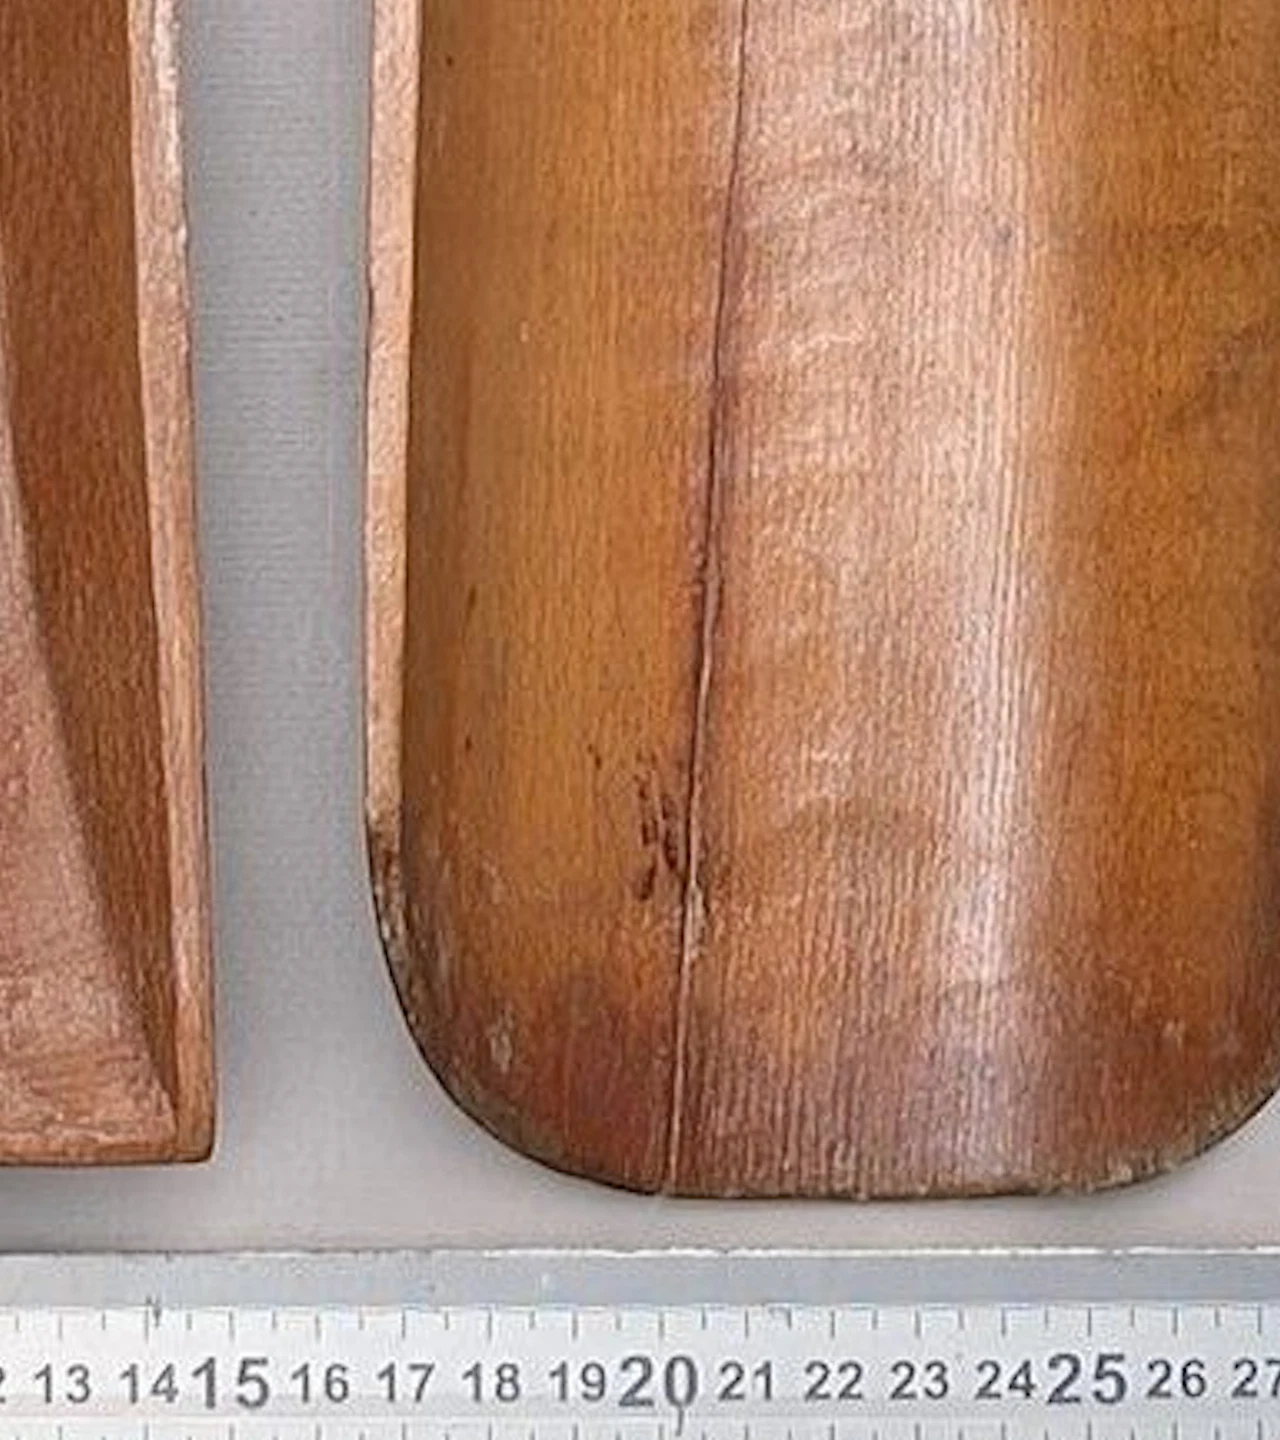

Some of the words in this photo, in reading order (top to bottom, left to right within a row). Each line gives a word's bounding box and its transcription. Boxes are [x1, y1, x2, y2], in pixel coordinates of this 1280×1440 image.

[34, 1364, 91, 1404] 13
[120, 1363, 179, 1405] 14
[192, 1357, 269, 1410] 15
[291, 1363, 349, 1404] 16
[377, 1362, 435, 1403] 17
[462, 1362, 520, 1403] 18
[549, 1361, 606, 1402] 19
[618, 1355, 697, 1411] 20
[718, 1361, 772, 1402] 21
[804, 1360, 864, 1402] 22
[890, 1360, 949, 1400] 23
[975, 1360, 1036, 1400] 24
[1046, 1353, 1127, 1405] 25
[1146, 1358, 1206, 1399] 26
